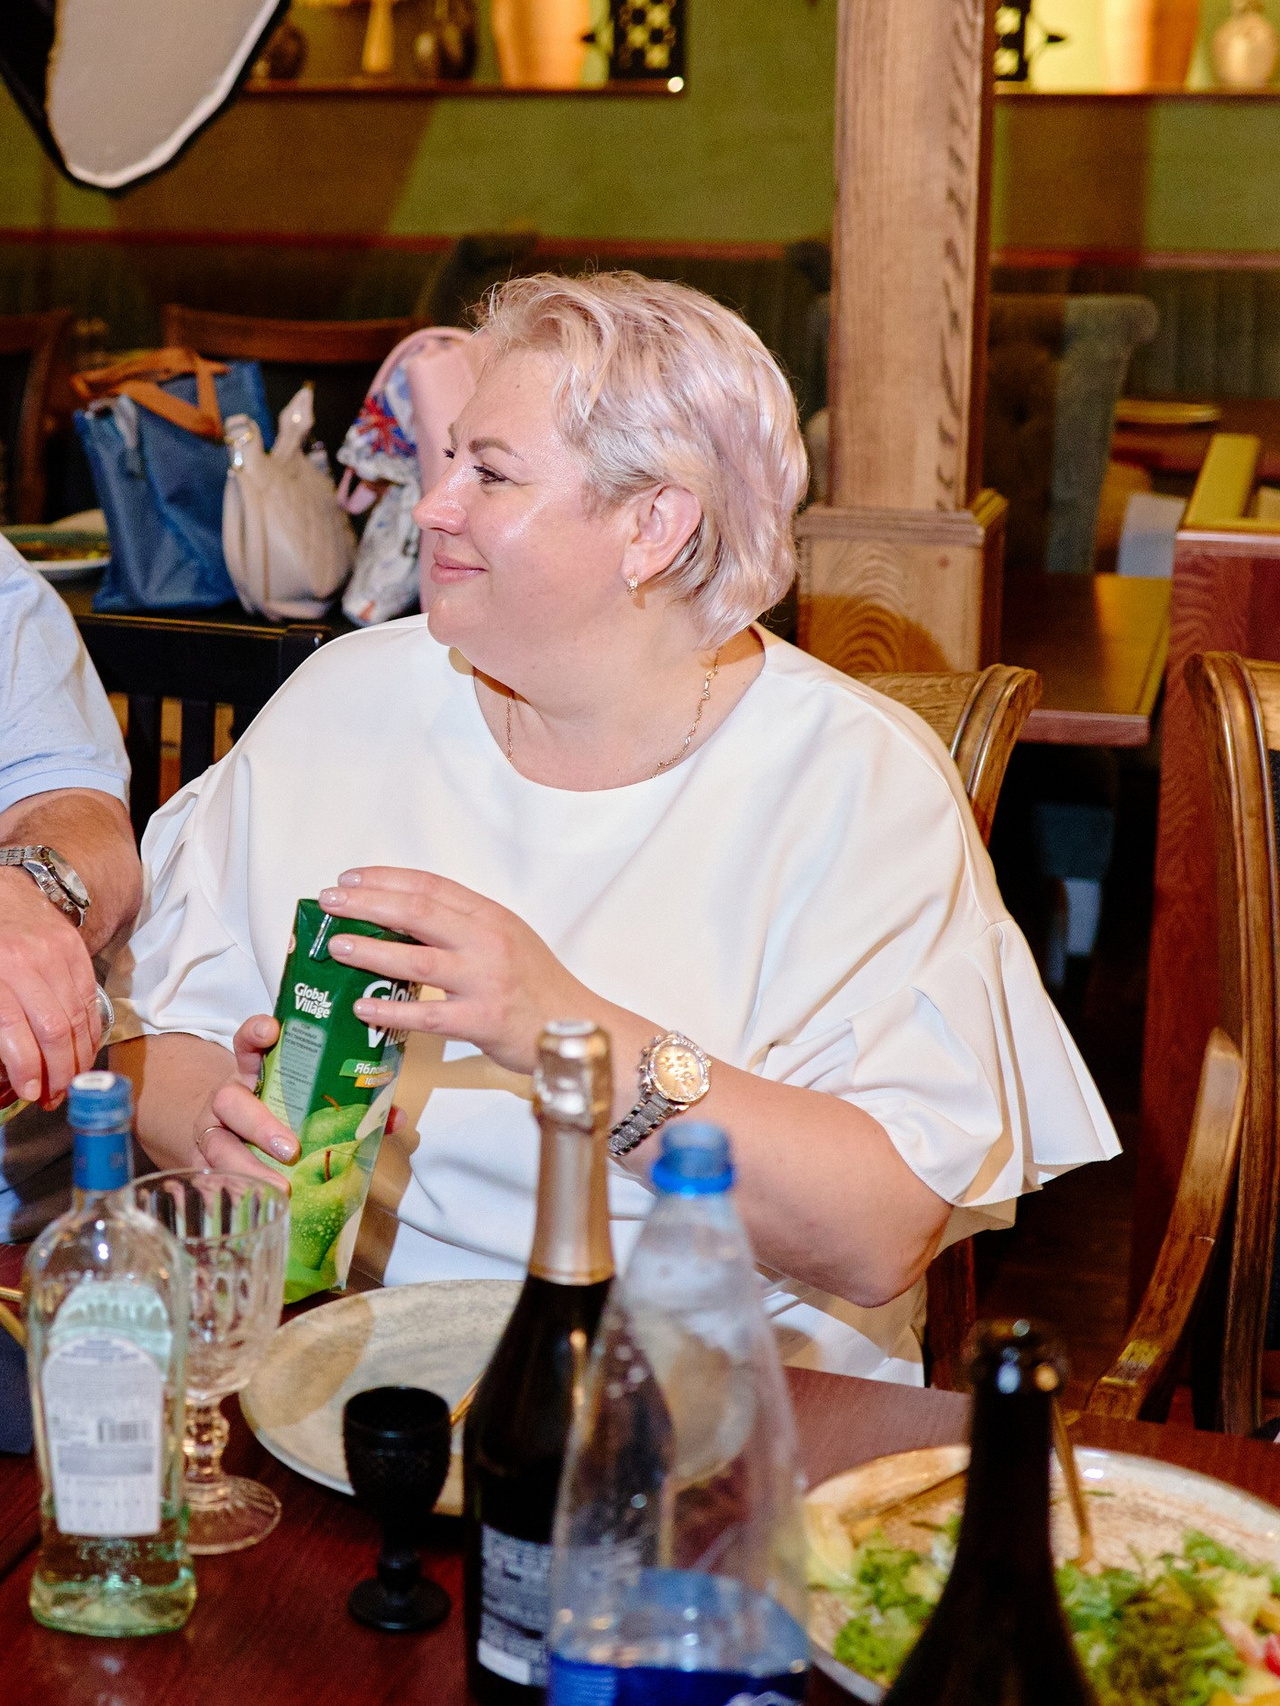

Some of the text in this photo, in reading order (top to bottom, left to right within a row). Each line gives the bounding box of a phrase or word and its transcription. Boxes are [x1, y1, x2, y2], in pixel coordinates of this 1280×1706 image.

[294, 982, 330, 1003] Global
[362, 980, 418, 1002] Glo
[295, 996, 331, 1019] Village
[354, 1062, 388, 1075] Ябл
